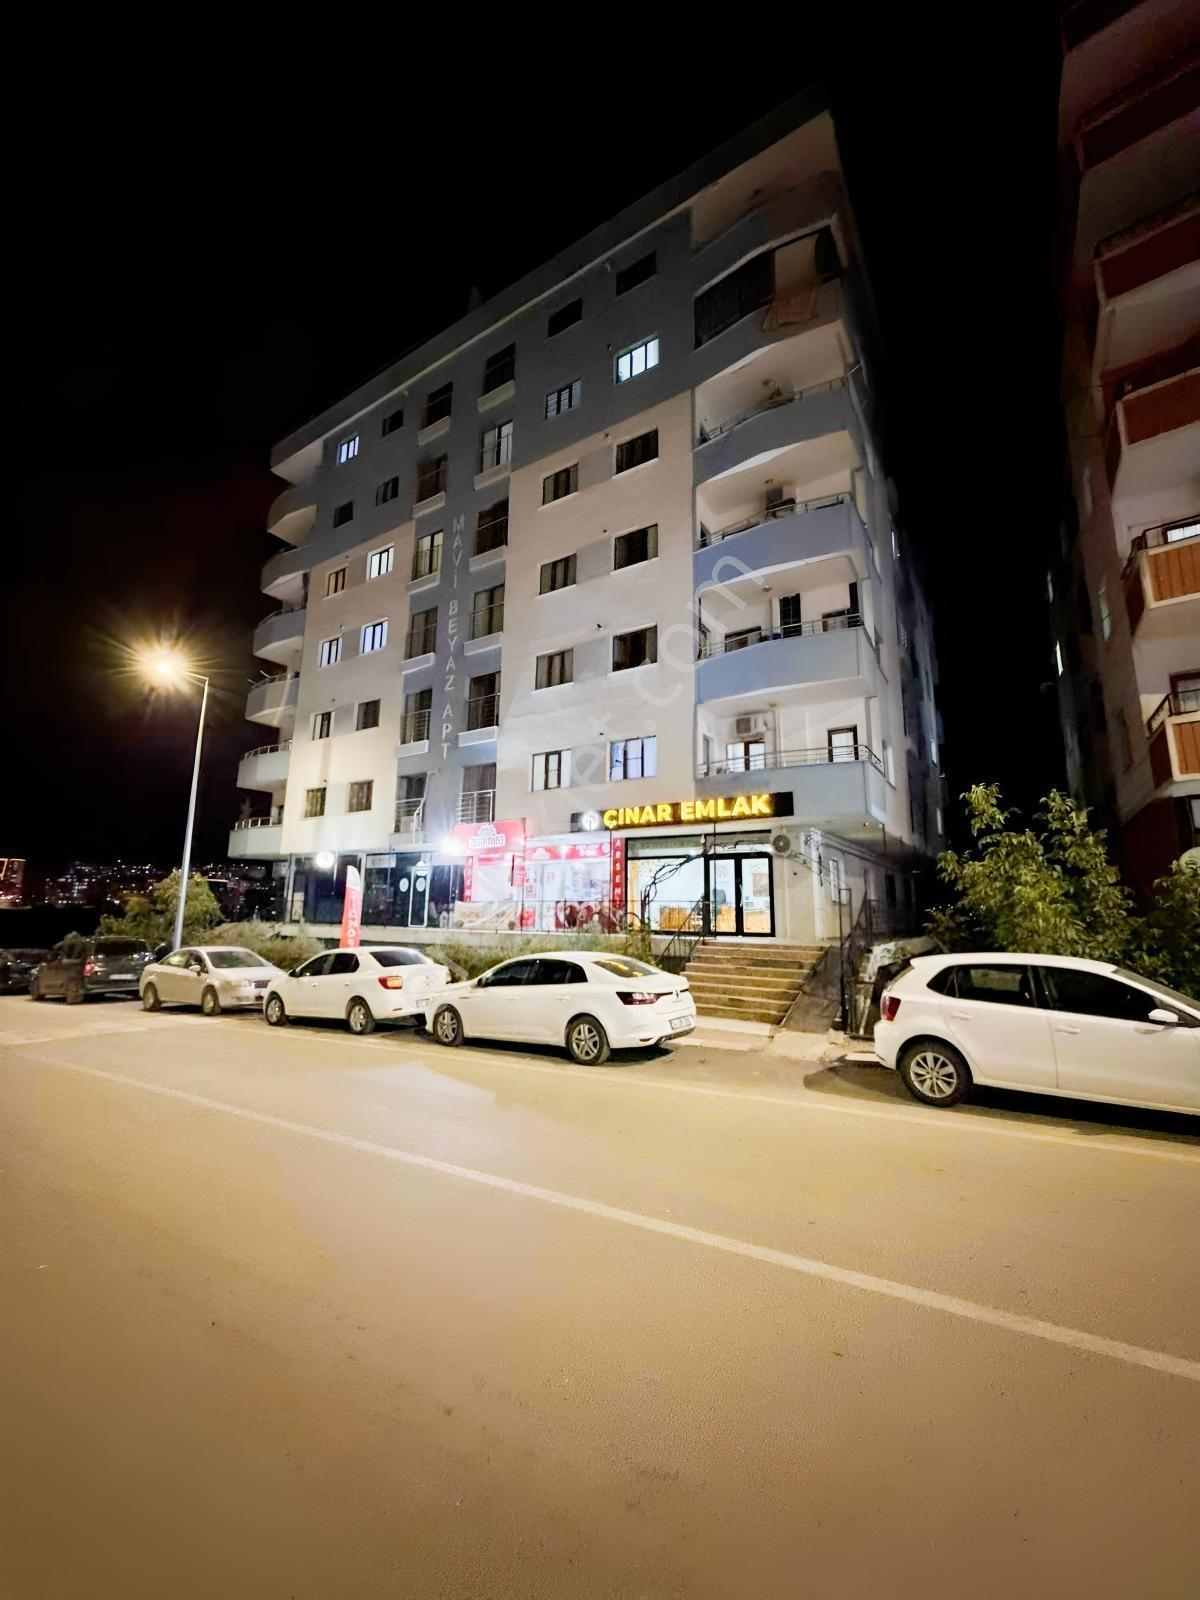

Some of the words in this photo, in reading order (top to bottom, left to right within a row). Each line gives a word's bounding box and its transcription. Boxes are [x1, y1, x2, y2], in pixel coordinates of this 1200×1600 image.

[444, 599, 460, 691] BEYAZ
[440, 703, 454, 760] APT
[603, 806, 673, 829] ÇINAR
[680, 794, 771, 821] EMLAK
